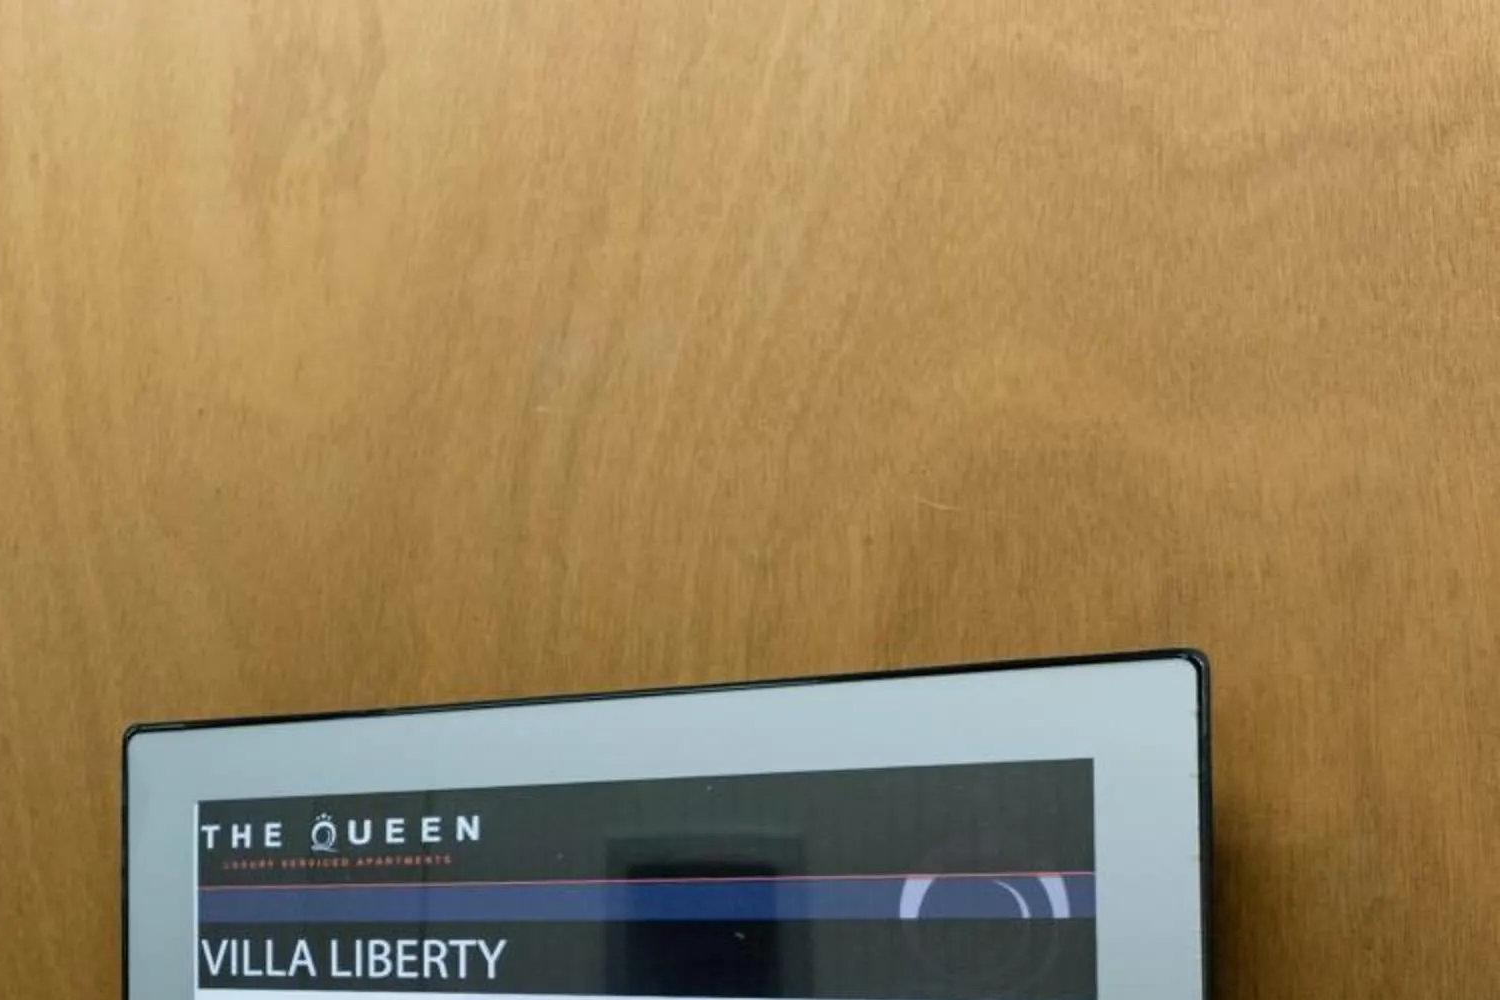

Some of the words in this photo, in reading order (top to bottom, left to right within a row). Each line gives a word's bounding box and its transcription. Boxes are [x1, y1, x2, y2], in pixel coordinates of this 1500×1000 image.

[201, 822, 282, 849] THE
[311, 815, 481, 852] QUEEN
[201, 938, 317, 977] VILLA
[330, 938, 508, 980] LIBERTY
